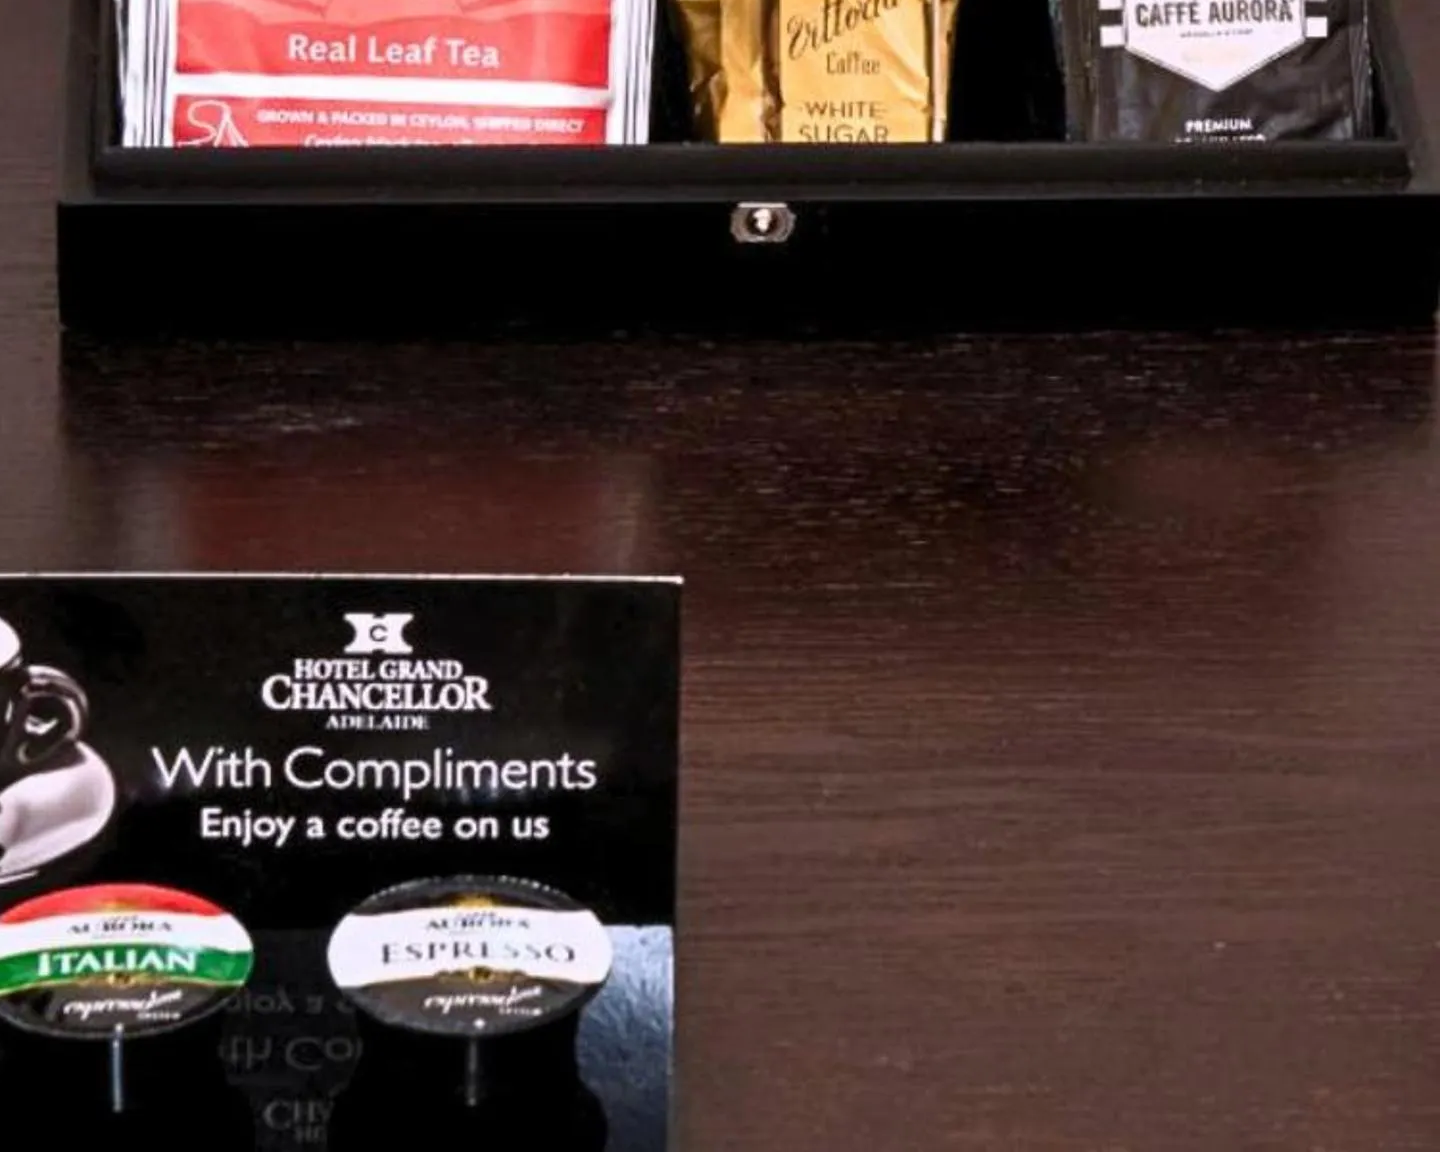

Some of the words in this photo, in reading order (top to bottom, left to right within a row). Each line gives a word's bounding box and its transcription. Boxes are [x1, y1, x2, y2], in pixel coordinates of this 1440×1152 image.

[288, 35, 356, 64] Real
[366, 36, 436, 65] Leaf
[445, 40, 500, 69] Tea
[826, 51, 881, 75] Coffee
[805, 100, 887, 119] WHITE
[799, 123, 890, 143] SUGAR
[1184, 117, 1254, 133] PREMIUM
[294, 658, 376, 681] HOTEL
[379, 659, 464, 681] GRAND
[261, 674, 493, 711] CHANCELLOR
[325, 714, 432, 731] ADELAIDE
[151, 747, 272, 789] With
[284, 746, 598, 801] Compliments
[200, 807, 295, 848] Enjoy
[306, 814, 325, 839] a
[336, 808, 443, 840] coffee
[454, 814, 499, 839] on
[511, 815, 551, 840] us
[37, 951, 198, 978] ITALIAN
[381, 941, 577, 965] ESPRESSO
